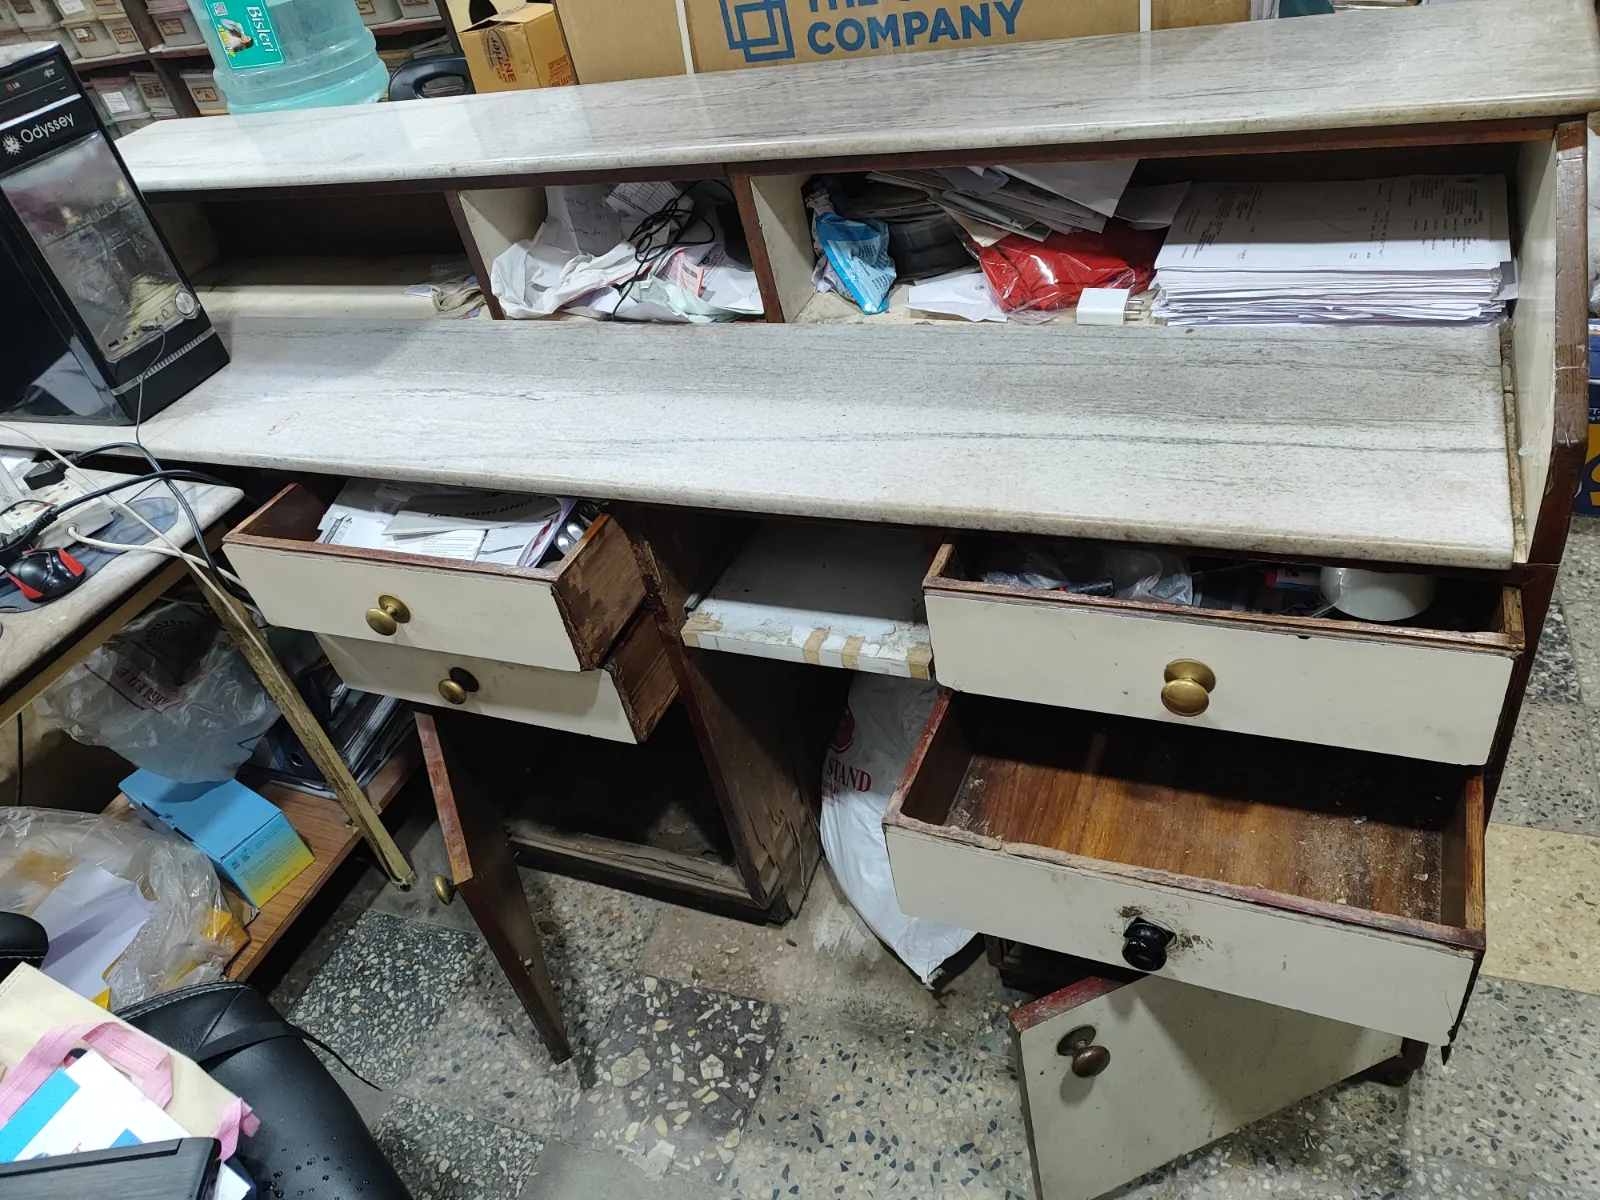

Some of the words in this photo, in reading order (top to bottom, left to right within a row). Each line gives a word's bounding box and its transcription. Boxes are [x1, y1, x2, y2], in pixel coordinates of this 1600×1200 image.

[246, 7, 278, 52] Bisleri
[807, 0, 1023, 54] COMPANY
[20, 113, 74, 143] Odyssey
[827, 756, 872, 793] STAND
